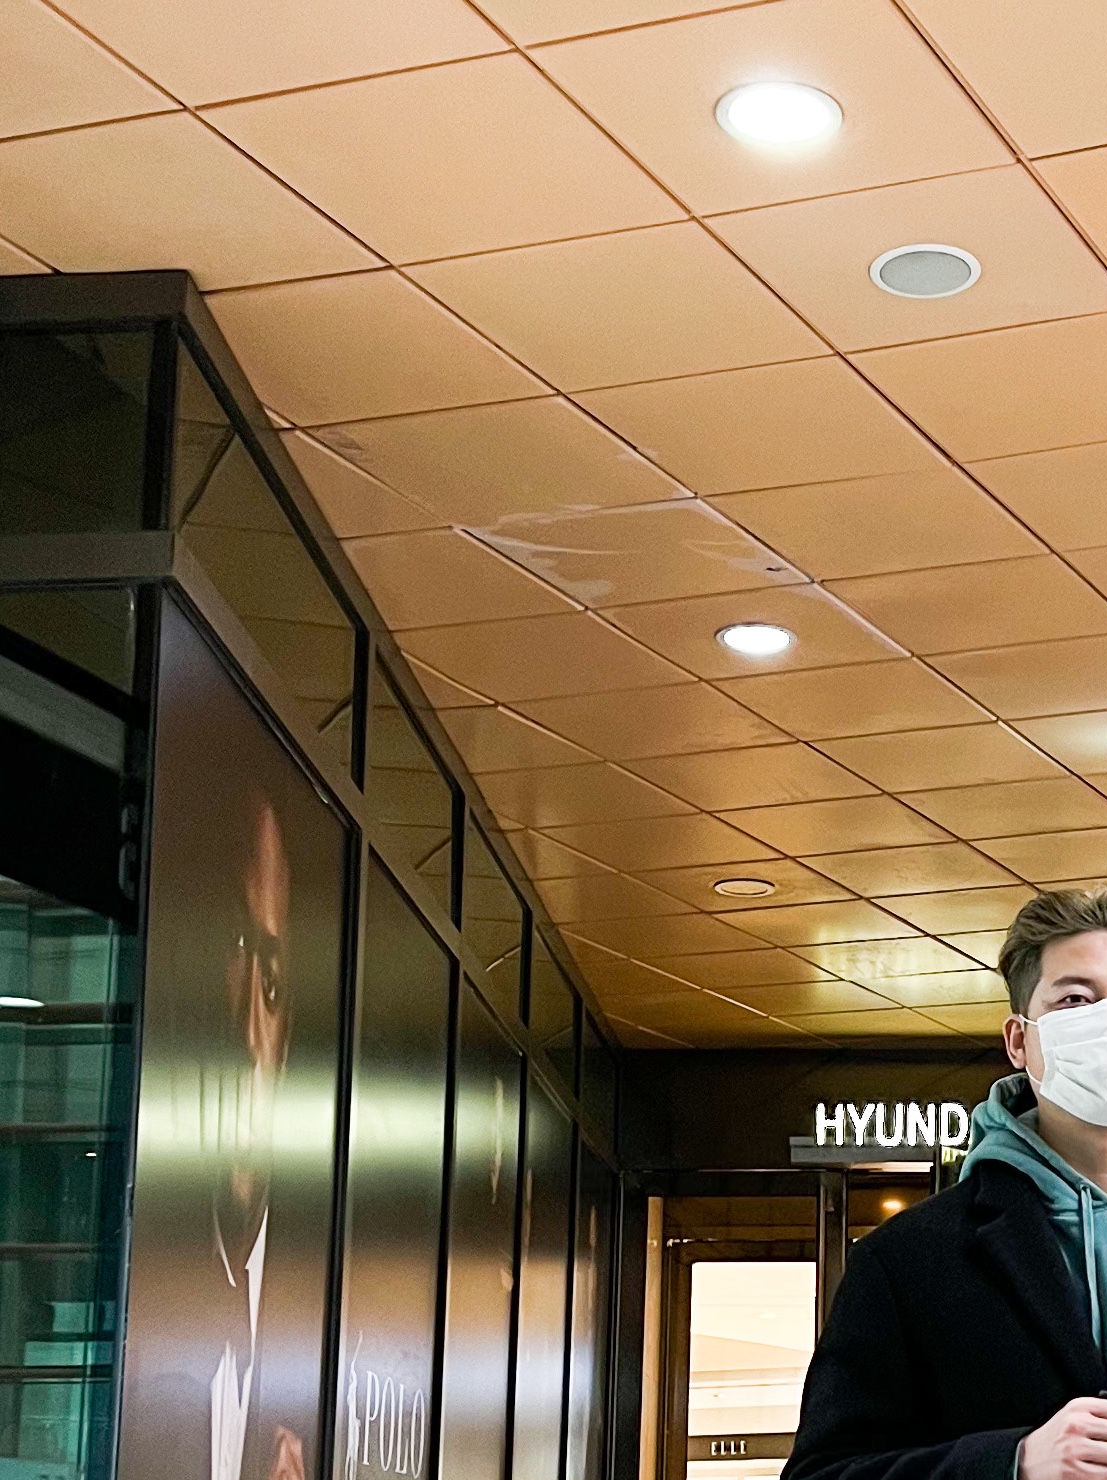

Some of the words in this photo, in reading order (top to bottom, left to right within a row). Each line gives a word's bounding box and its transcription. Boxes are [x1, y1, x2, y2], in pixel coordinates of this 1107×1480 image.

[815, 1102, 972, 1147] HYUND
[362, 1370, 425, 1479] POLO
[711, 1440, 747, 1456] ELLE
